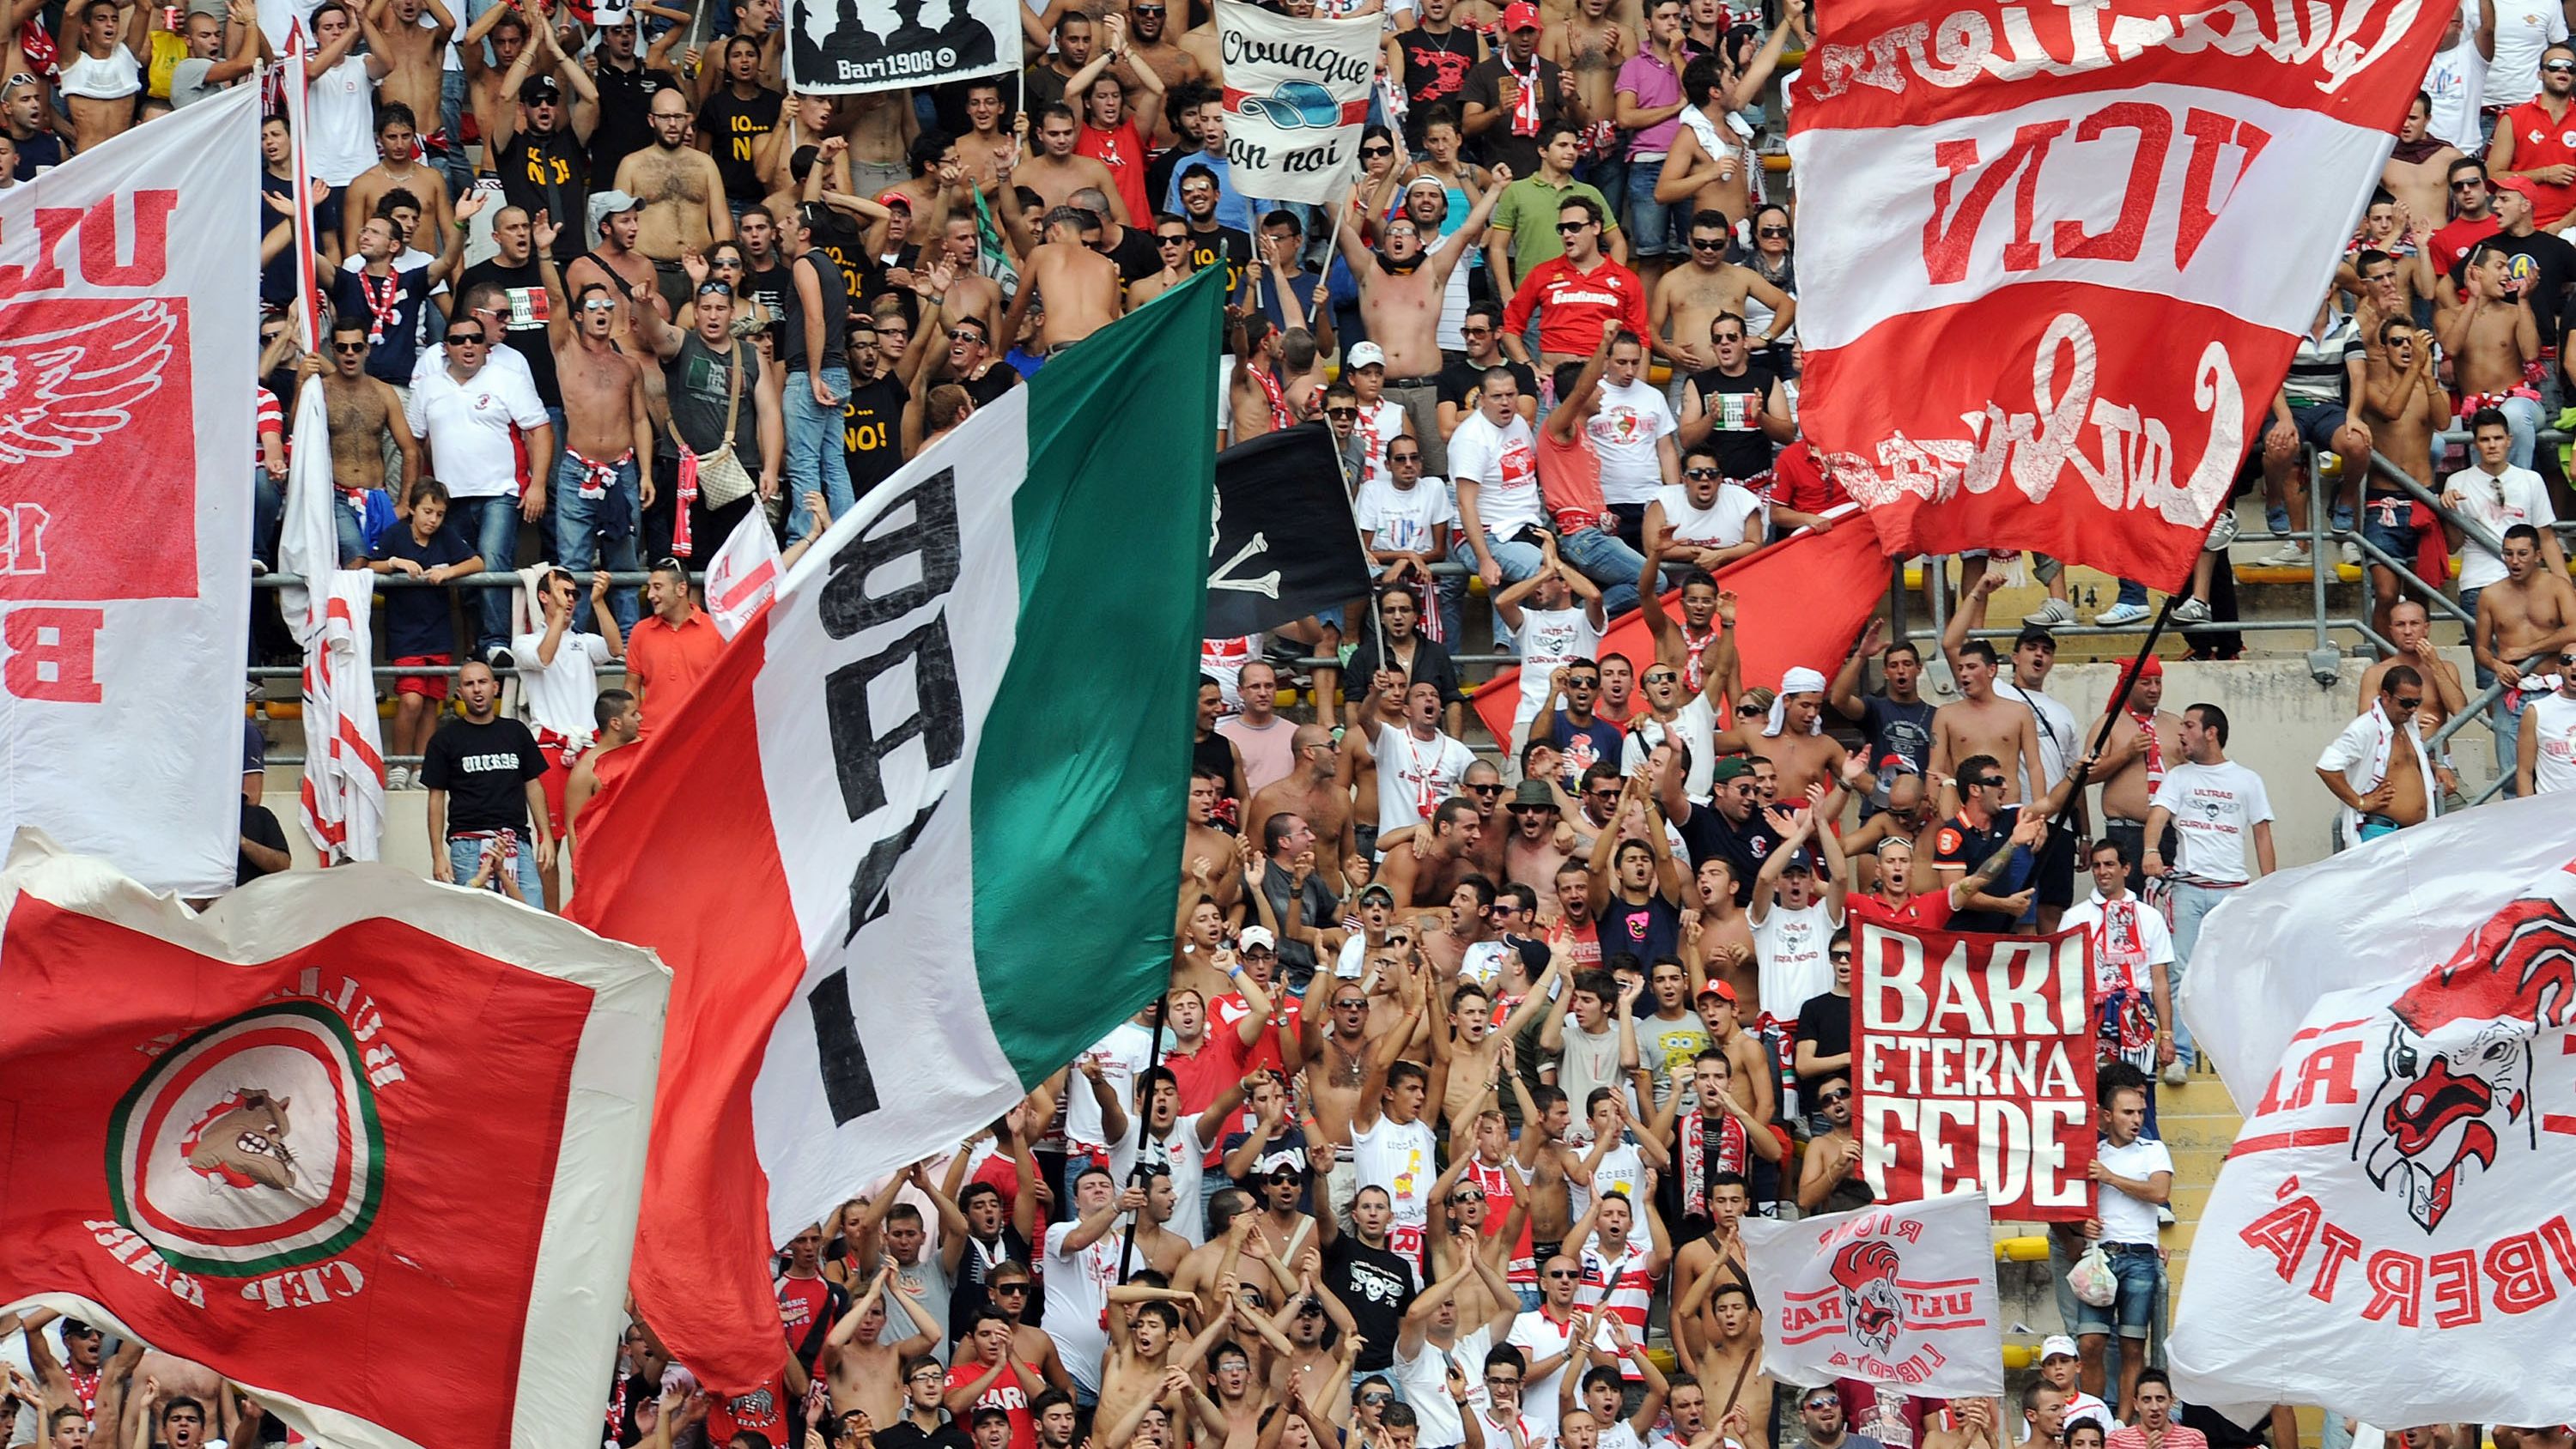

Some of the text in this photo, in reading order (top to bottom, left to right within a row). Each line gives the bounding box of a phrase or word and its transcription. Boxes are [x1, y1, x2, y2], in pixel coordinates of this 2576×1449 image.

[1224, 130, 1341, 172] on noi
[2069, 585, 2097, 608] 14
[2194, 788, 2233, 799] ULTRAS
[2178, 819, 2239, 834] CURVA NORD
[1862, 923, 2087, 1035] BARI
[1862, 1034, 2085, 1098] ETERNA
[1862, 1094, 2088, 1207] FEDE
